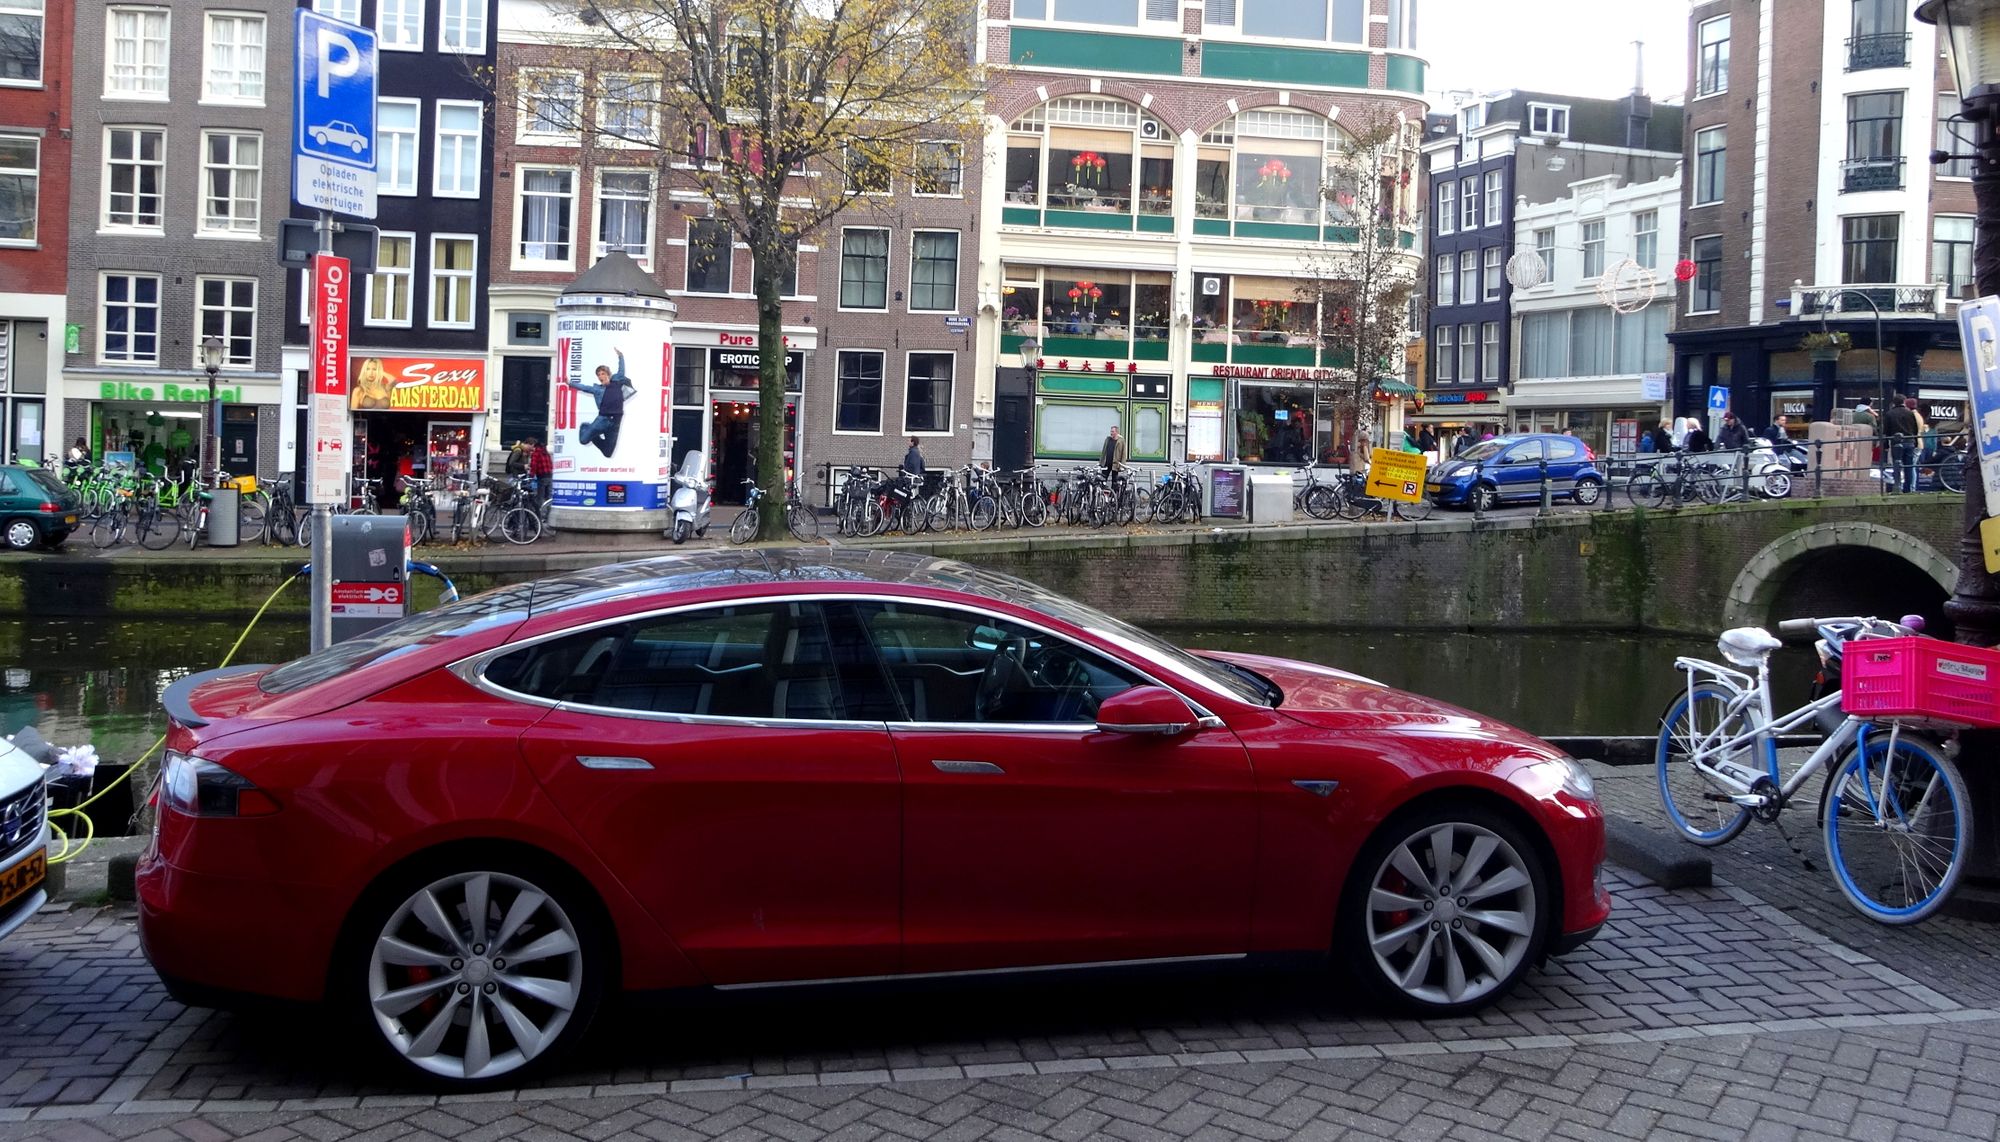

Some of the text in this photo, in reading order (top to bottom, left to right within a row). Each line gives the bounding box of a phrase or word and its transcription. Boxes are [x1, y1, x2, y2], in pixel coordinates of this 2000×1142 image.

[318, 28, 360, 99] P
[320, 164, 357, 181] Opladen
[312, 179, 364, 198] elektrische
[314, 194, 363, 212] voertuigen
[322, 266, 343, 387] Oplaadpunt
[575, 320, 598, 331] GELIEFDE
[720, 333, 753, 345] Pure
[571, 337, 583, 372] MUSICAL
[720, 353, 760, 365] EROTIC
[395, 362, 478, 389] Sexy
[1213, 365, 1332, 381] RESTAURANT ORIENTAL CITY
[101, 382, 155, 400] Bike
[390, 385, 480, 409] AMSTERDAM
[1783, 403, 1805, 413] YUCCA
[1931, 405, 1957, 417] YUCCA
